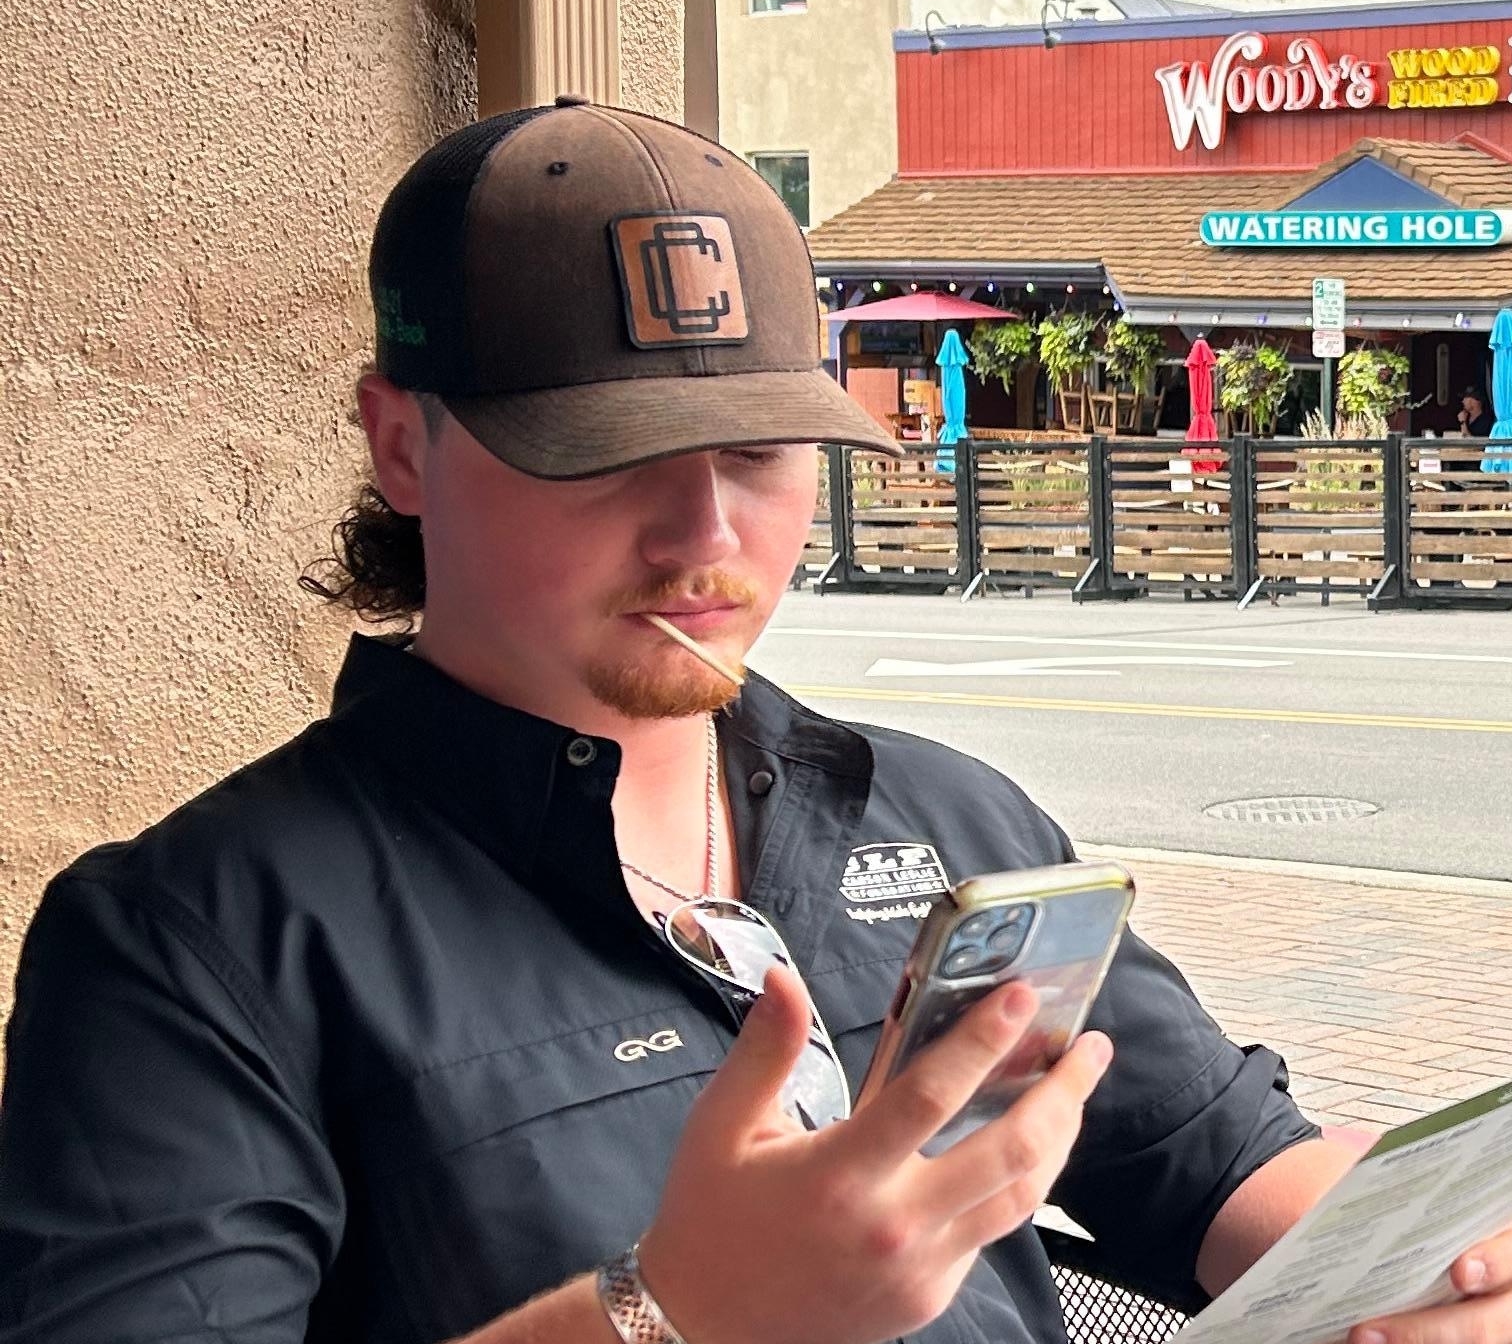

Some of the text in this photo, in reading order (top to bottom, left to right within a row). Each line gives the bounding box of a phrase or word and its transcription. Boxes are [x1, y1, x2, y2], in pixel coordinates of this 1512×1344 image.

[1387, 45, 1500, 78] WOOD
[1387, 76, 1500, 109] FIRED
[1207, 215, 1496, 241] WATERING HOLE
